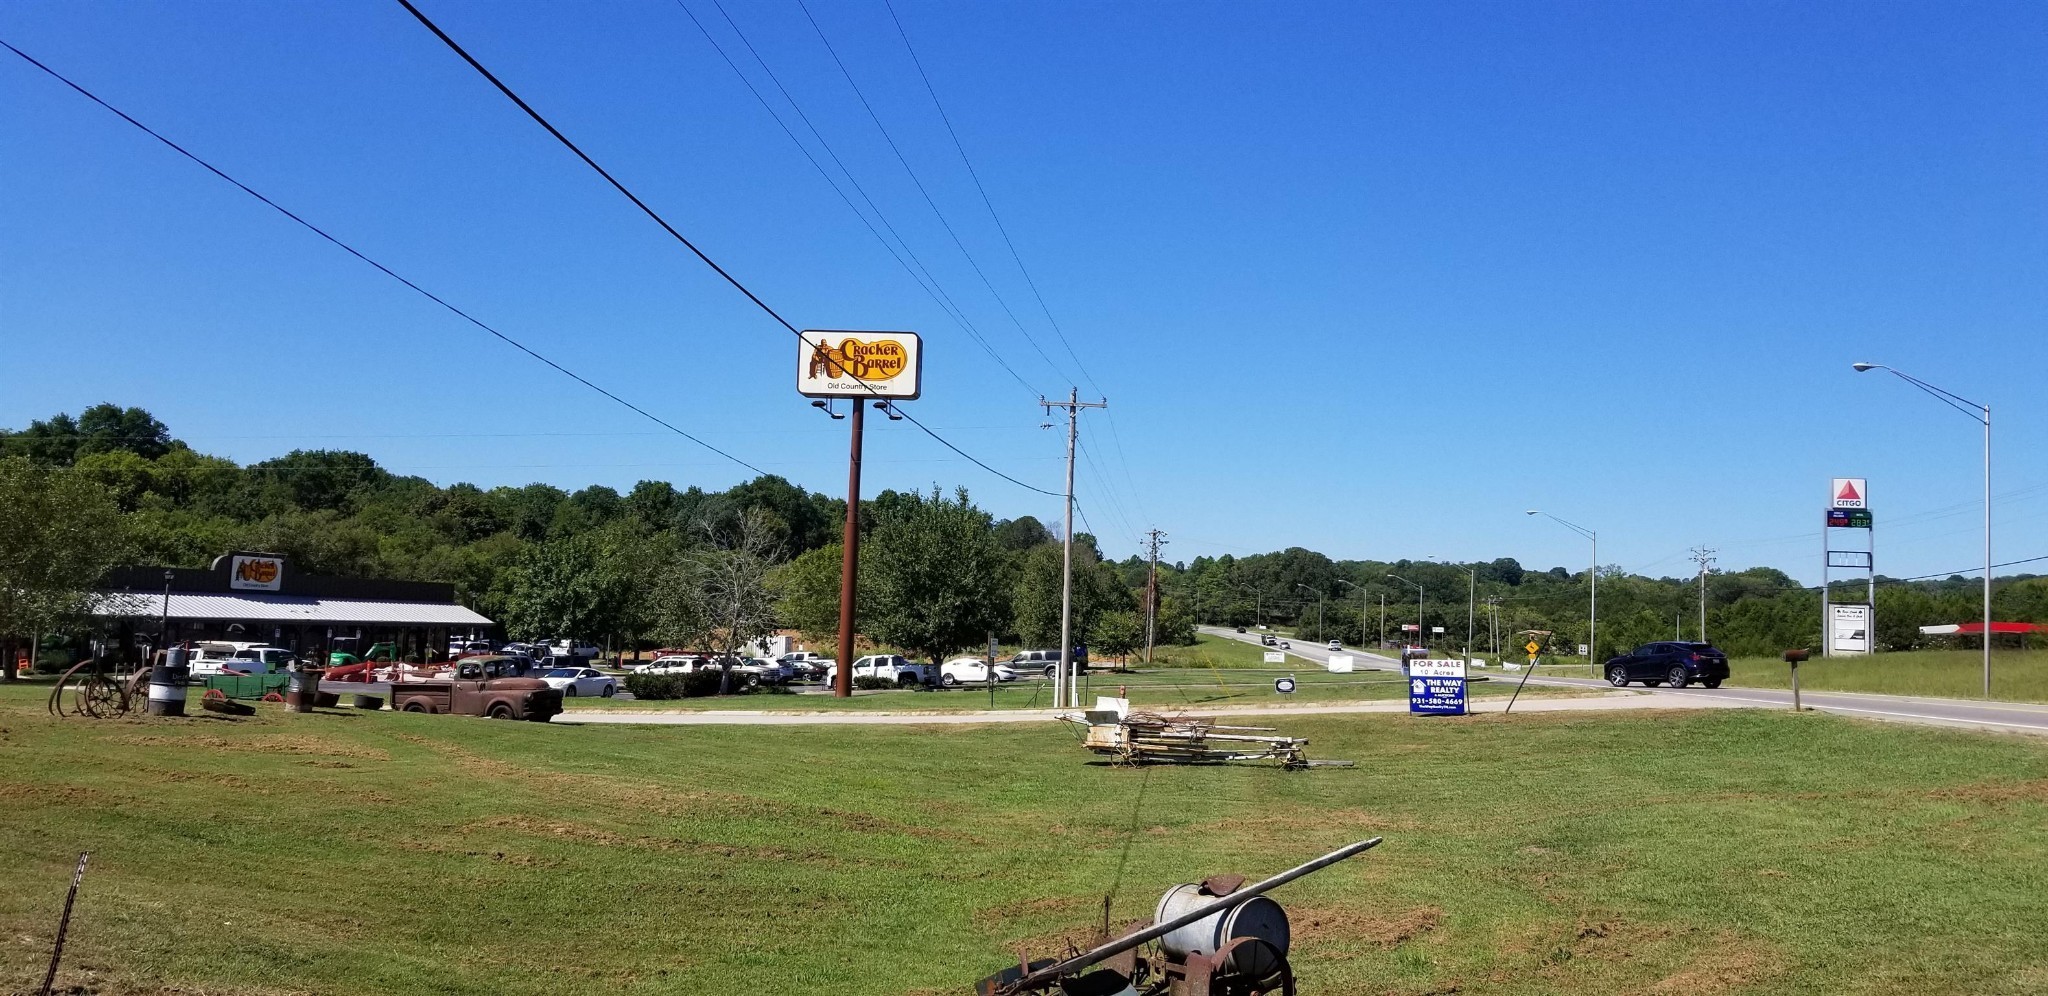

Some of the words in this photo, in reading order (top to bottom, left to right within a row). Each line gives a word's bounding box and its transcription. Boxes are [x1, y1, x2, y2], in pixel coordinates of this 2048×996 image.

[841, 340, 898, 361] Cracker
[853, 355, 900, 378] Barrel
[841, 383, 867, 391] Country
